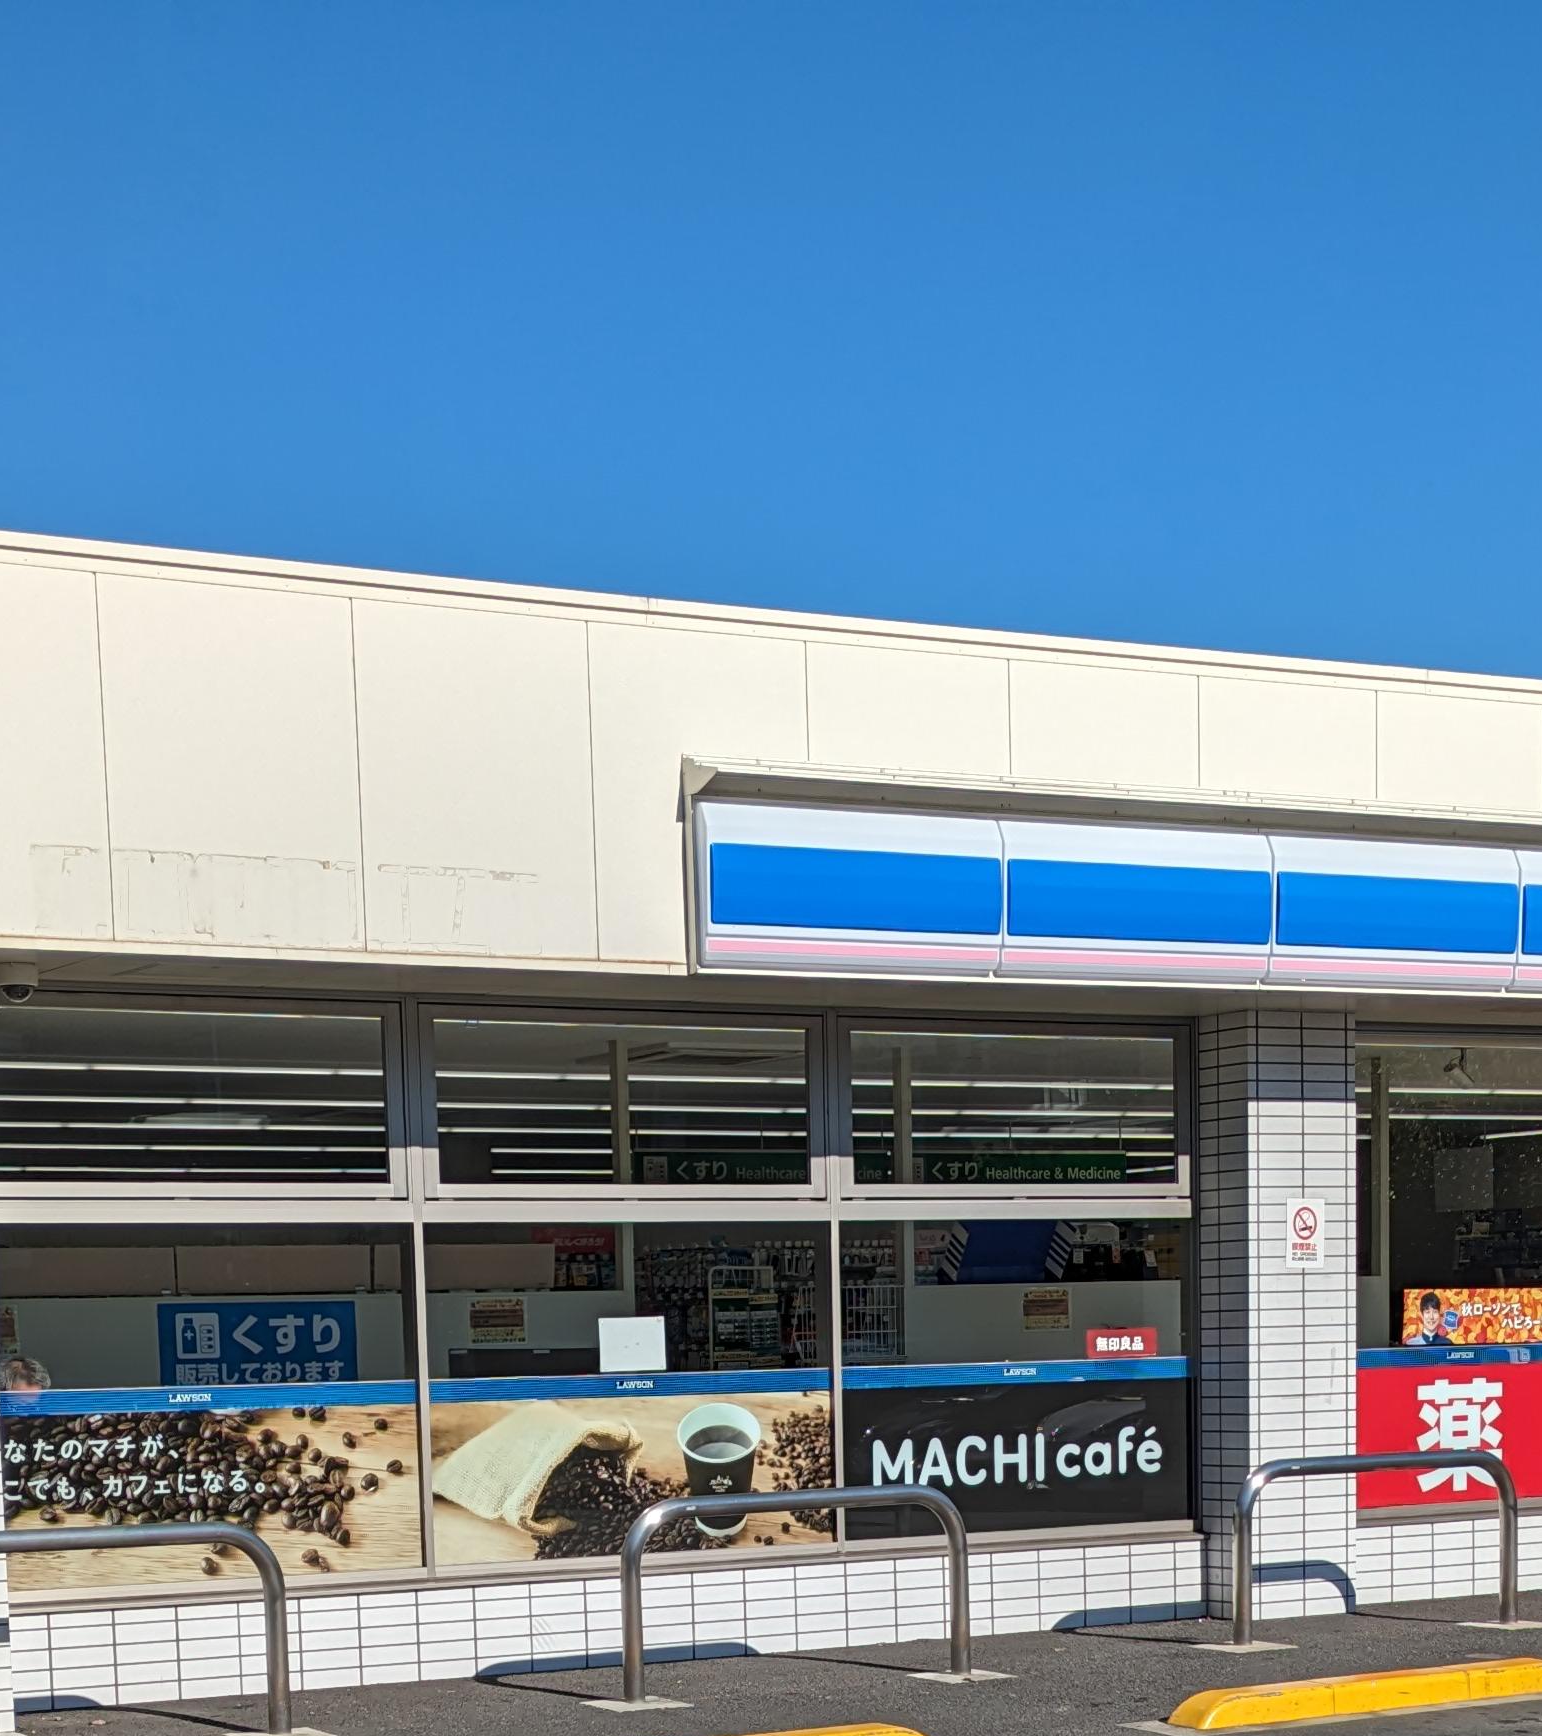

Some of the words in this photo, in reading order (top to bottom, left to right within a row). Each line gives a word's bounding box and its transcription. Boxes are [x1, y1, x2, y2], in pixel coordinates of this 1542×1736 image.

[676, 1160, 727, 1180] くすり
[736, 1167, 806, 1180] Healthcare
[932, 1161, 977, 1181] くすり
[986, 1167, 1050, 1179] Healthcare
[1054, 1167, 1063, 1179] &
[1067, 1167, 1121, 1179] Medicine
[1461, 1303, 1521, 1316] 秋ローソンで
[232, 1314, 342, 1354] くすり
[1096, 1336, 1144, 1351] 無印良品
[175, 1360, 345, 1385] 販売しております
[1003, 1368, 1037, 1376] LAWSON
[615, 1380, 654, 1389] LAWSON
[169, 1393, 211, 1403] LAWSON
[1416, 1377, 1504, 1493] 薬
[872, 1432, 1046, 1488] MACHI
[1056, 1425, 1163, 1479] café
